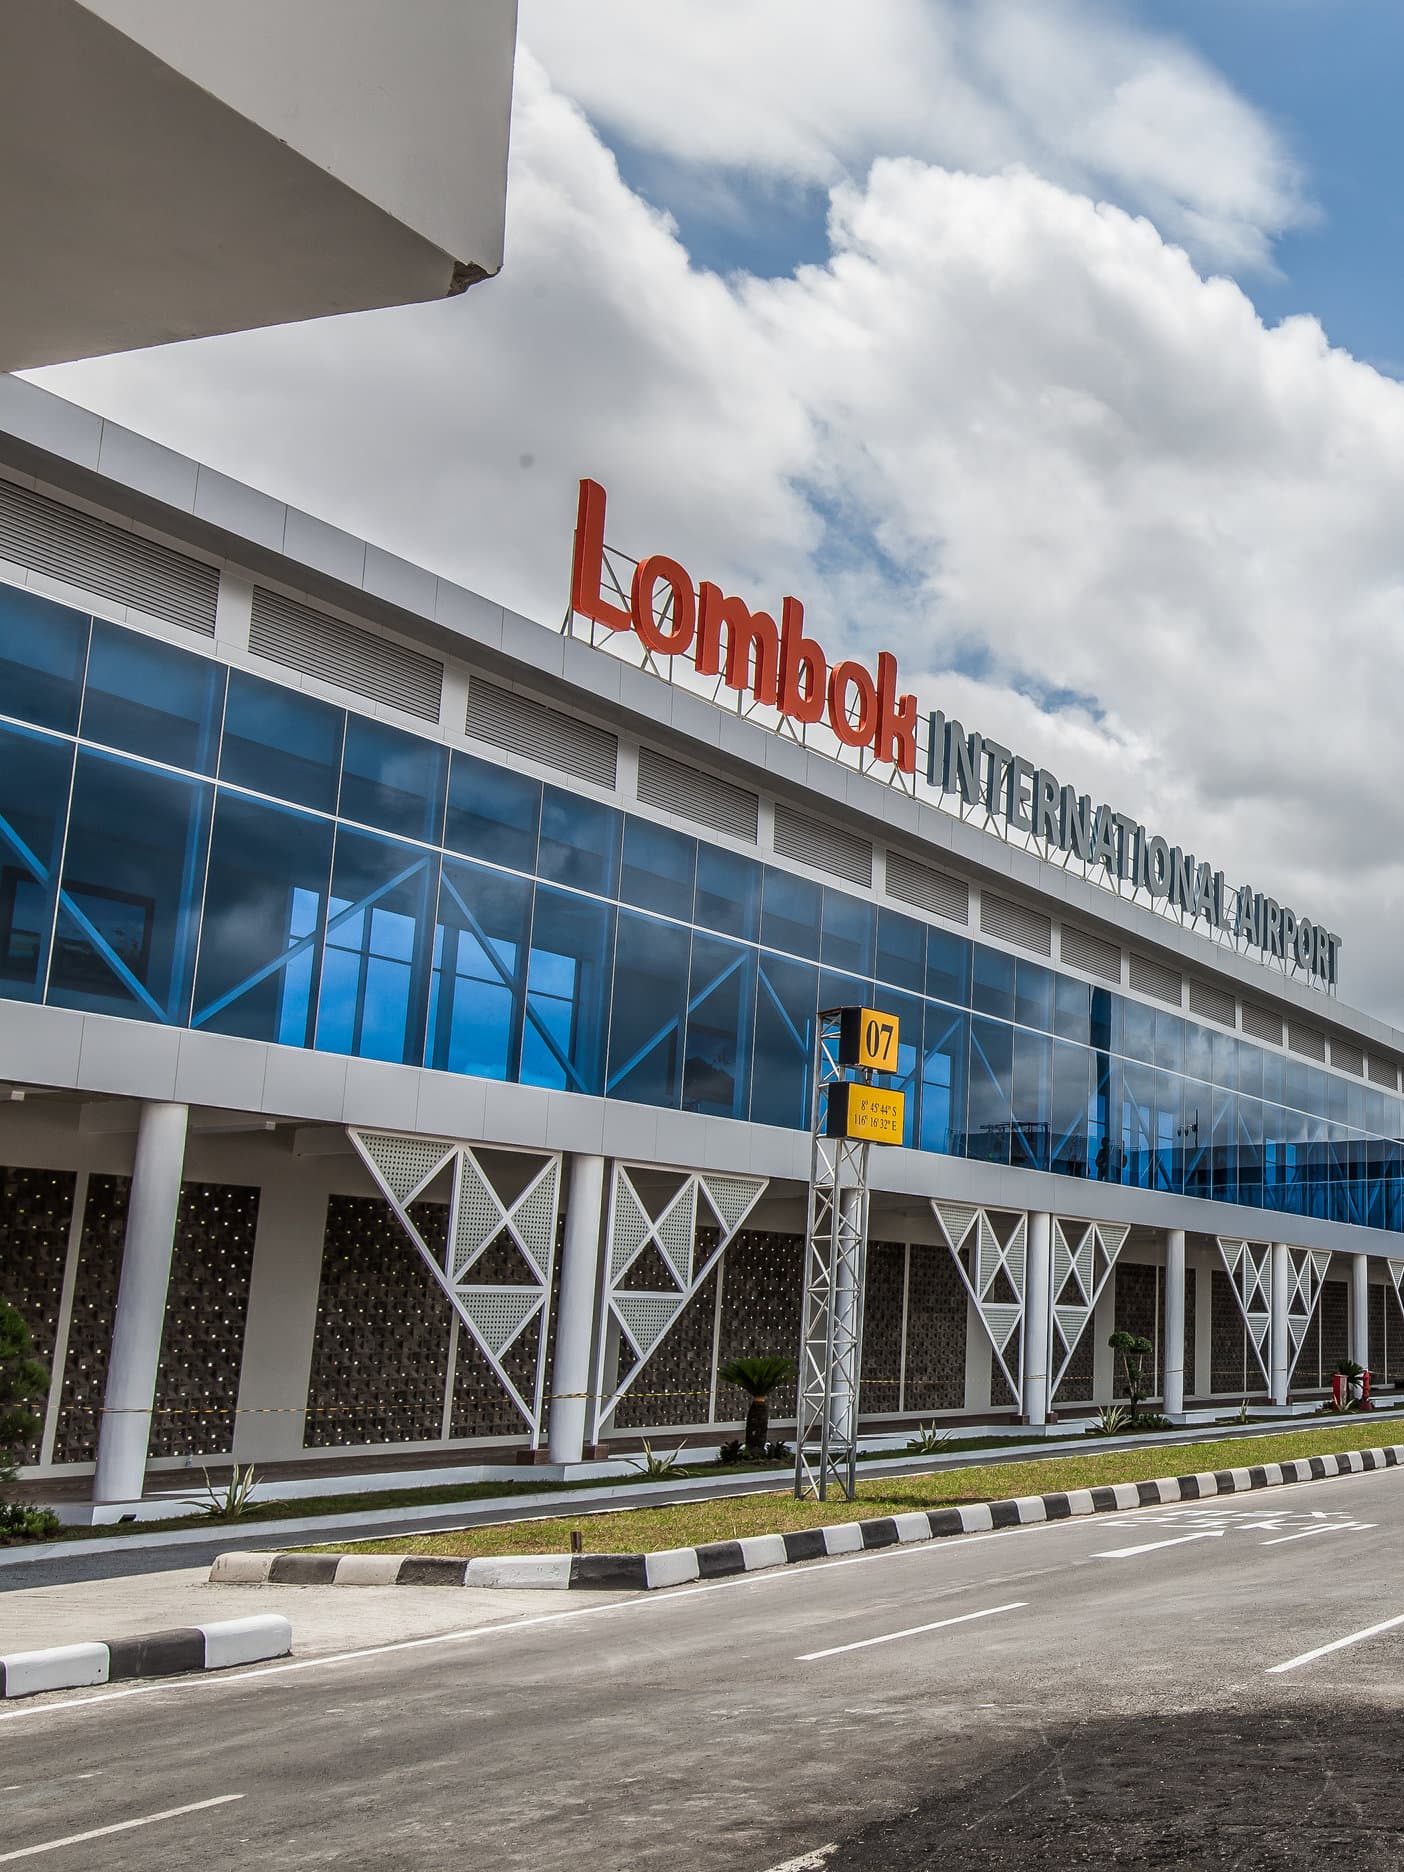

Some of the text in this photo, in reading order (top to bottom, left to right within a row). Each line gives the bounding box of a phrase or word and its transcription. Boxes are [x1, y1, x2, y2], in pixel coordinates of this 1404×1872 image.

[571, 478, 1343, 985] Lombok INTERNATIONAL AIRPORT
[866, 1020, 894, 1061] 07
[891, 1106, 897, 1117] S
[891, 1120, 897, 1132] E
